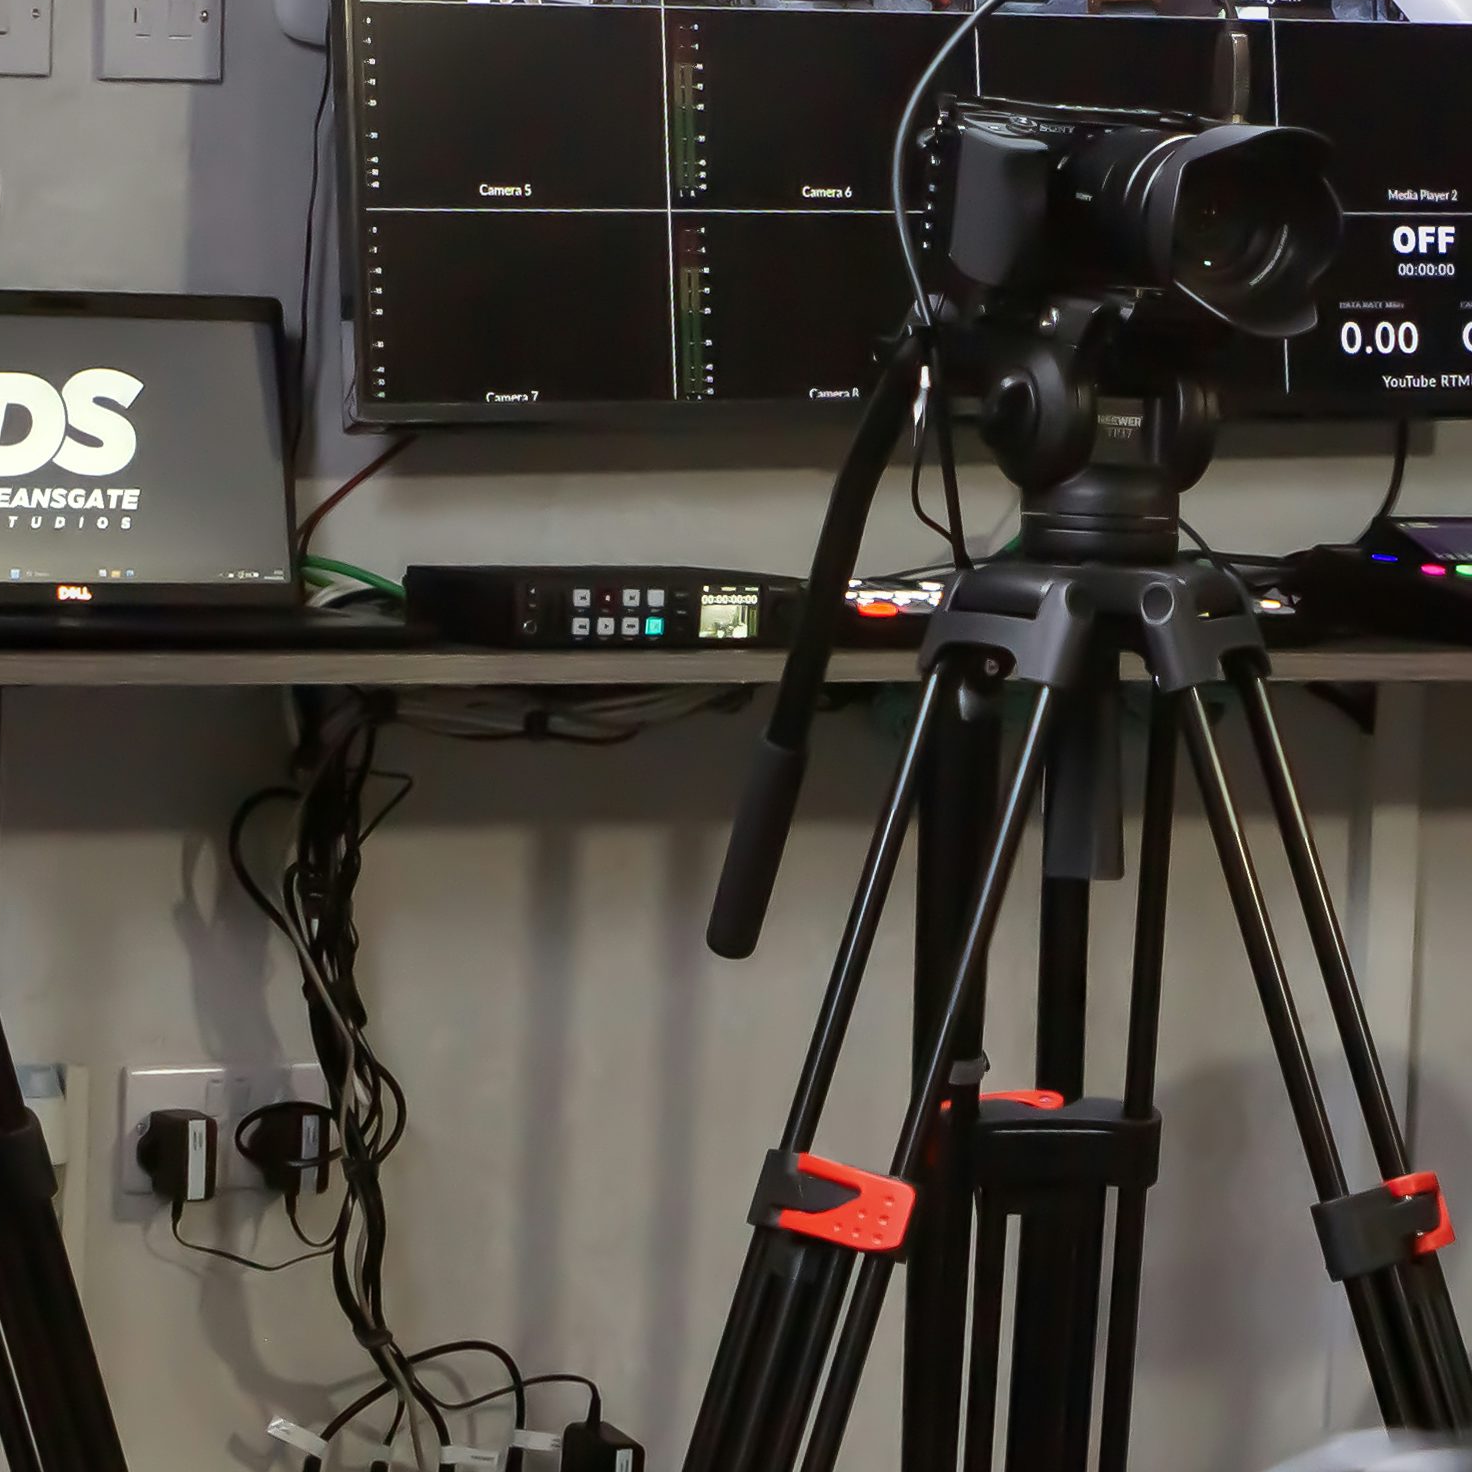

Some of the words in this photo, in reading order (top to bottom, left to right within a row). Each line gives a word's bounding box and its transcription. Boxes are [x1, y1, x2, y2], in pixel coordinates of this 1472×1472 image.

[480, 183, 522, 197] Camera
[524, 183, 532, 197] 5
[802, 185, 843, 198] Camera
[845, 185, 853, 198] 6
[1388, 189, 1419, 201] Media
[1420, 189, 1450, 203] Player
[1451, 189, 1458, 201] 2
[1393, 225, 1456, 254] OFF
[1398, 263, 1455, 276] 00:00:00
[1340, 321, 1419, 355] 0.00
[1382, 374, 1437, 388] YouTube
[486, 391, 529, 403] Camera
[809, 388, 850, 399] Camera
[57, 585, 92, 601] DELL
